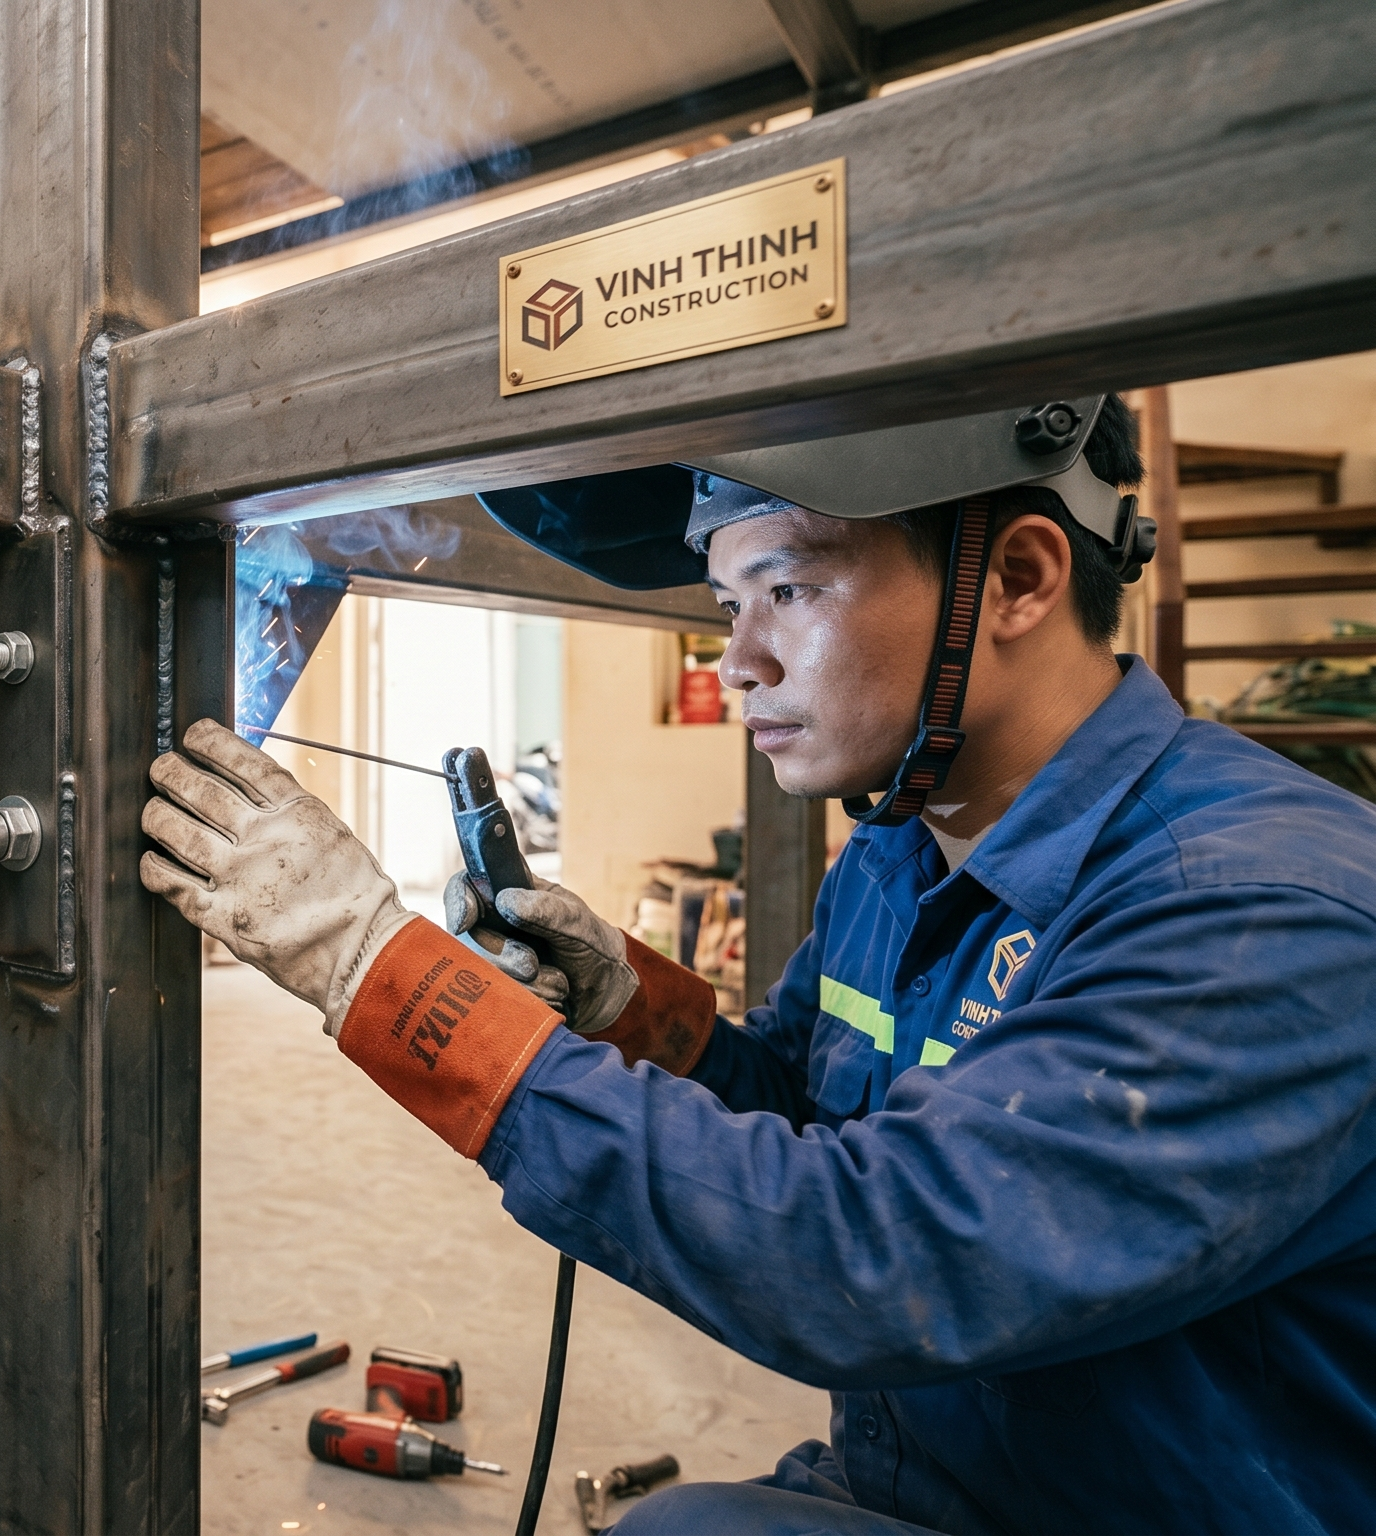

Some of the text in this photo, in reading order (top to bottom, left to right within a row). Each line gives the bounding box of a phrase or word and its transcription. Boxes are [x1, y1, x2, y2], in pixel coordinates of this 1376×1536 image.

[595, 220, 819, 302] VINH THINH
[604, 264, 809, 328] CONSTRUCTION
[959, 997, 992, 1025] VINH
